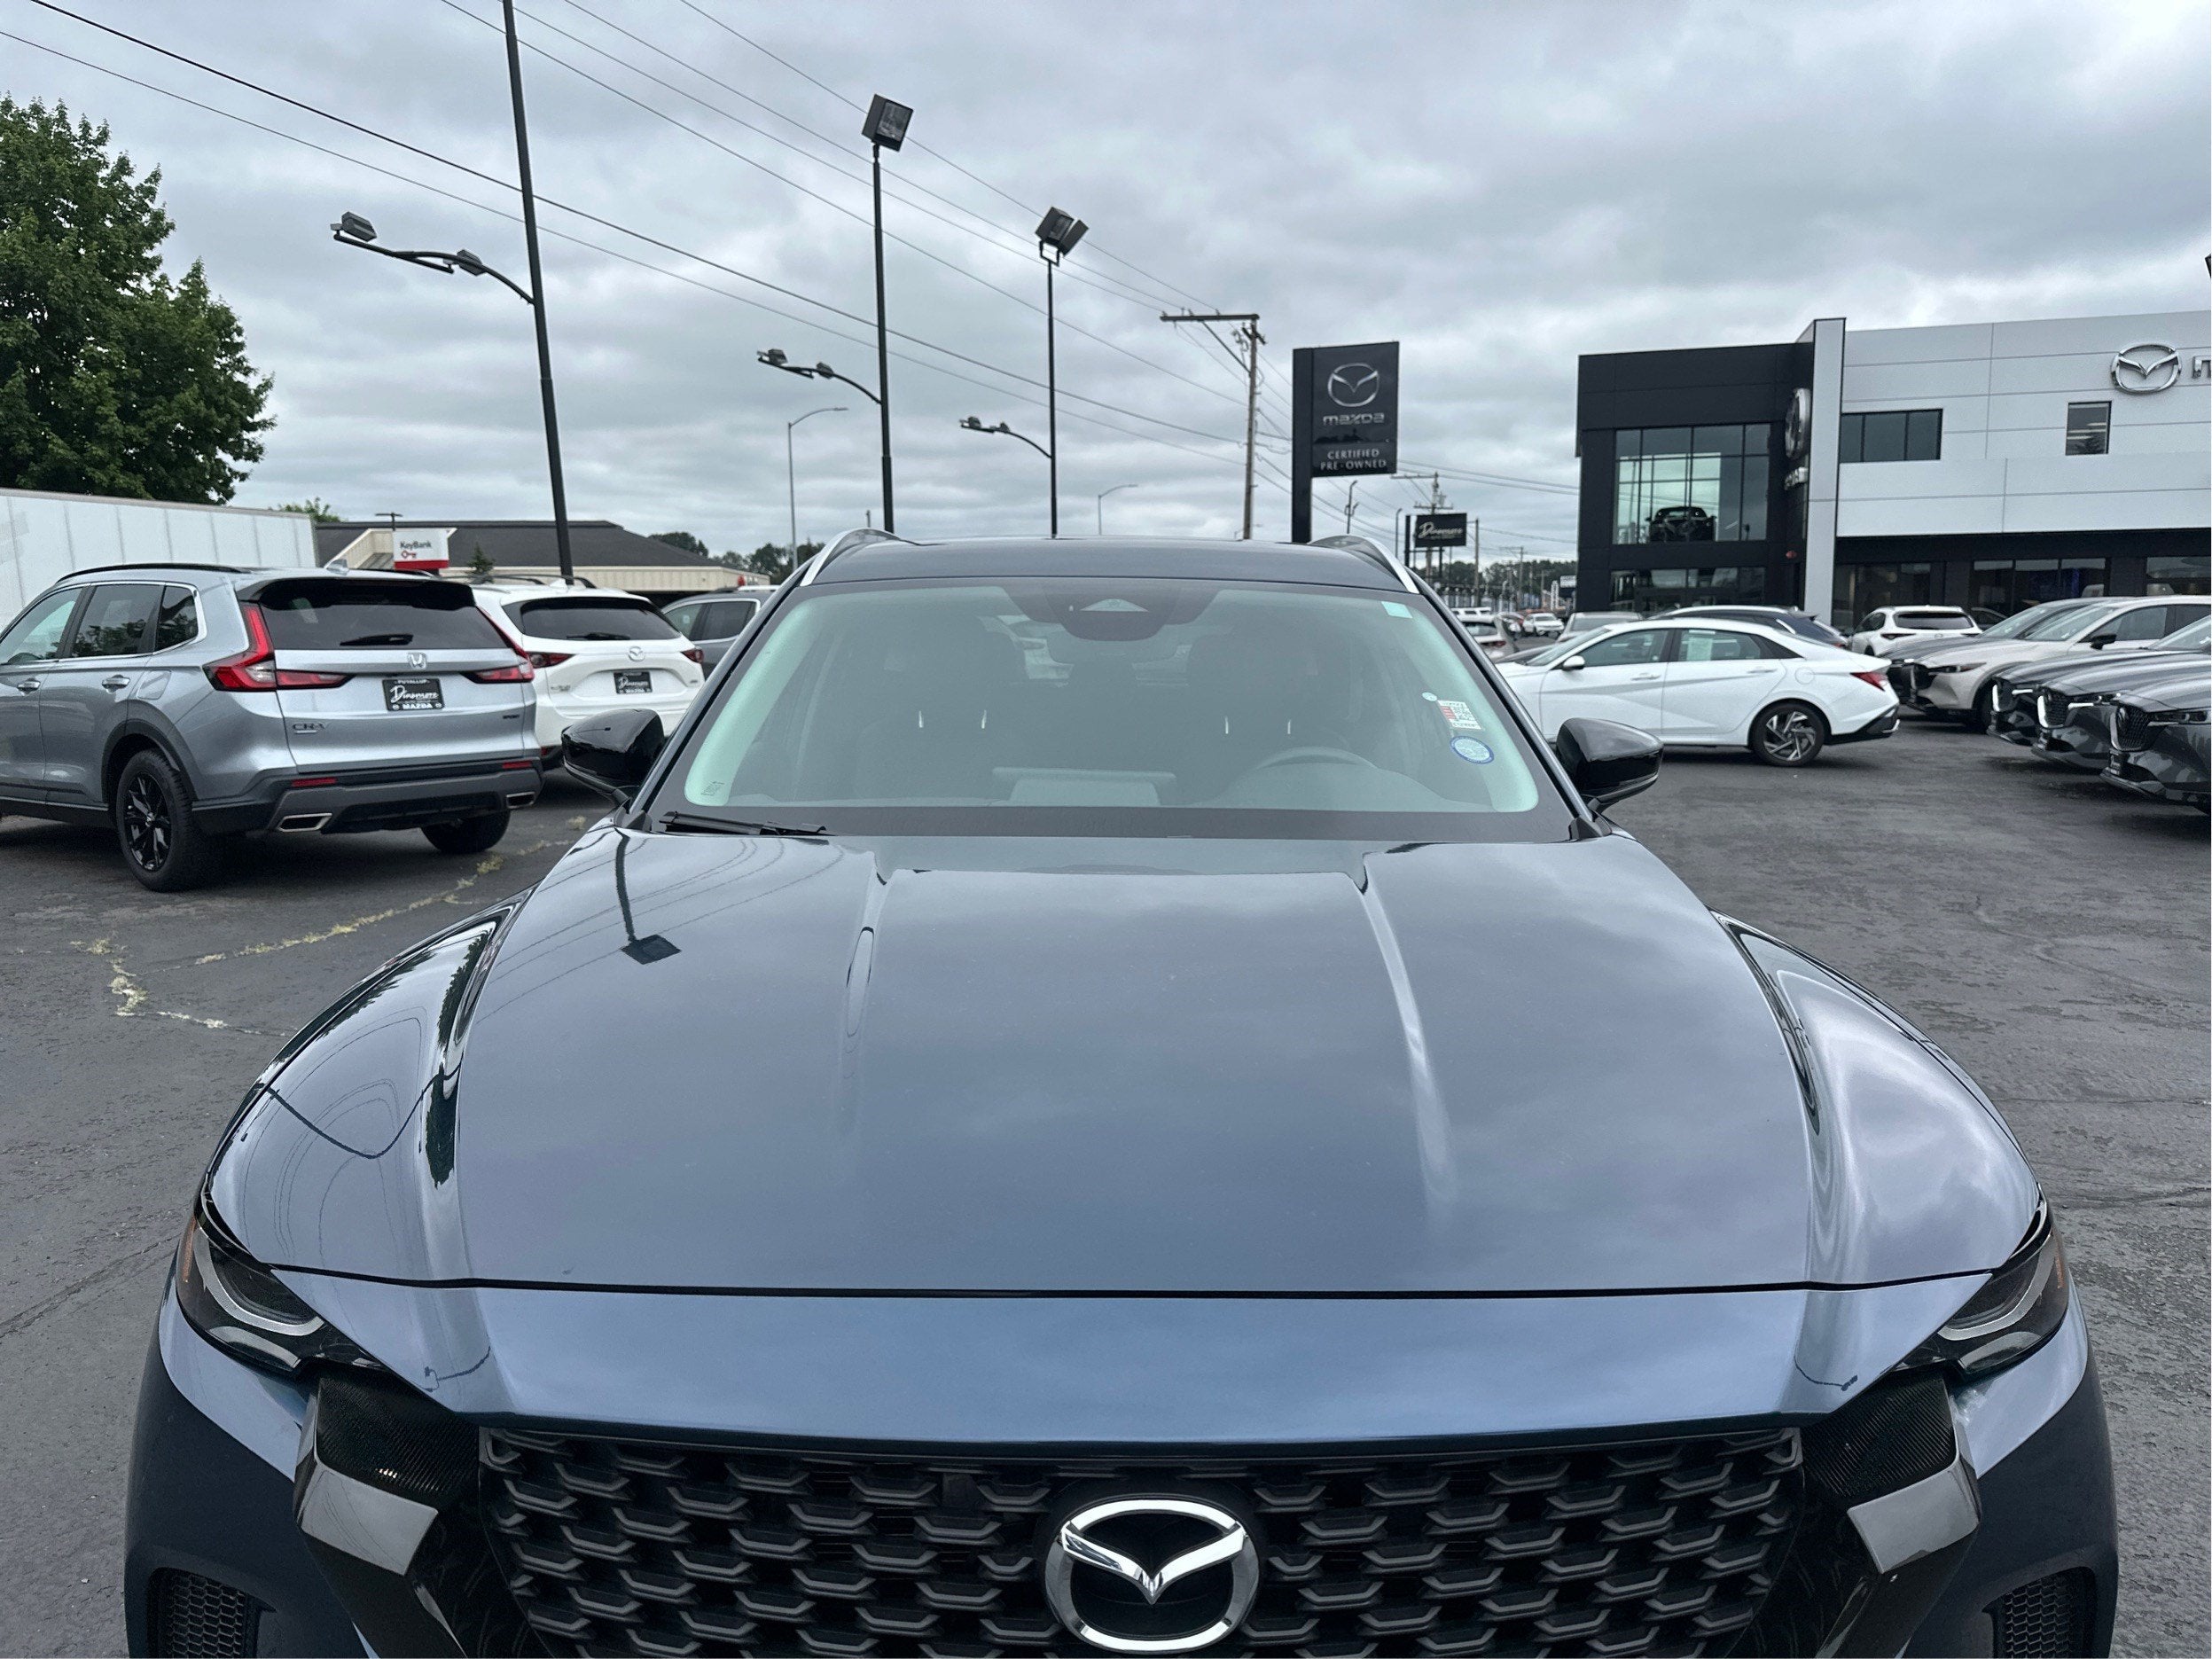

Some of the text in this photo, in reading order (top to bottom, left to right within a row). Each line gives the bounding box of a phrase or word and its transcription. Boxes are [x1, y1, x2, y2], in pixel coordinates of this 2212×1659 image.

[1323, 412, 1385, 426] mazda
[1327, 448, 1380, 460] CERTIFIED
[400, 540, 432, 551] KeyBank
